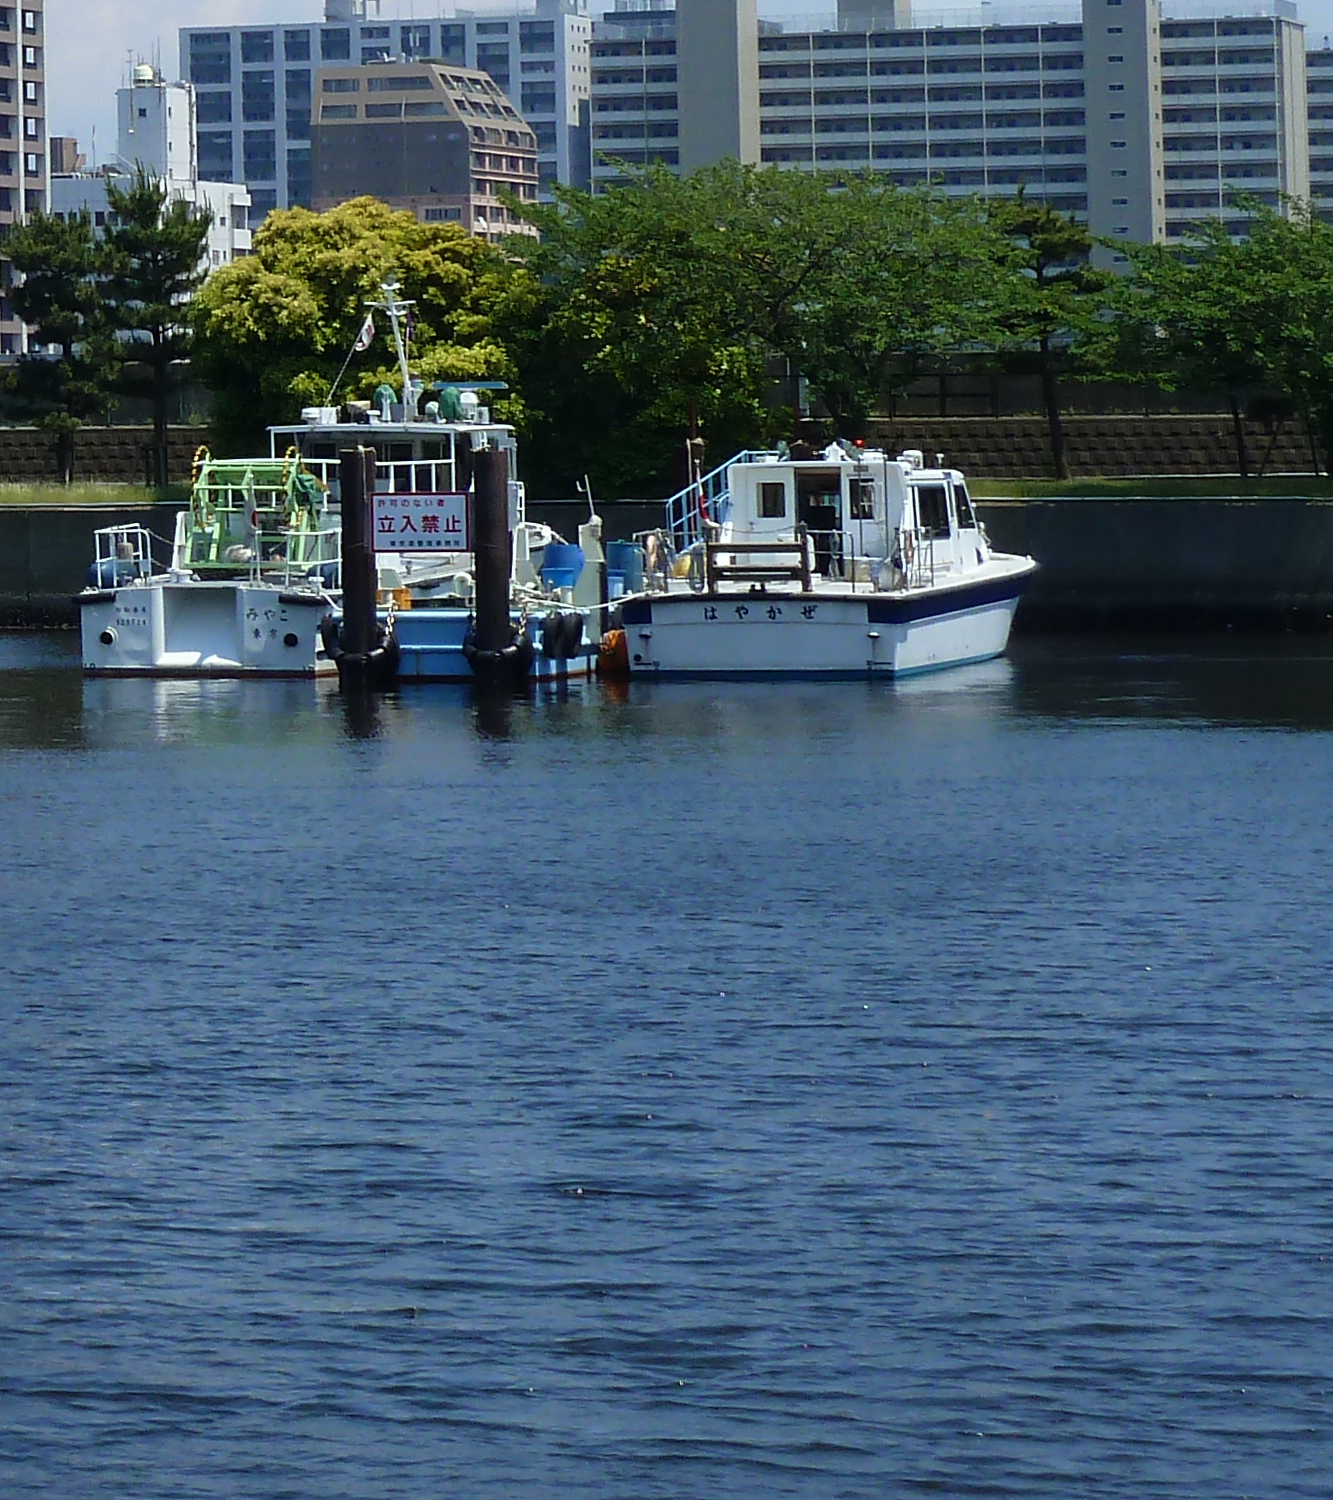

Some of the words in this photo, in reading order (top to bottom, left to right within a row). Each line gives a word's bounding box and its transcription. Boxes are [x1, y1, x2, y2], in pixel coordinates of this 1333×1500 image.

[378, 515, 462, 533] 立入禁止
[246, 608, 288, 621] みやこ
[704, 604, 818, 620] はやかぜ
